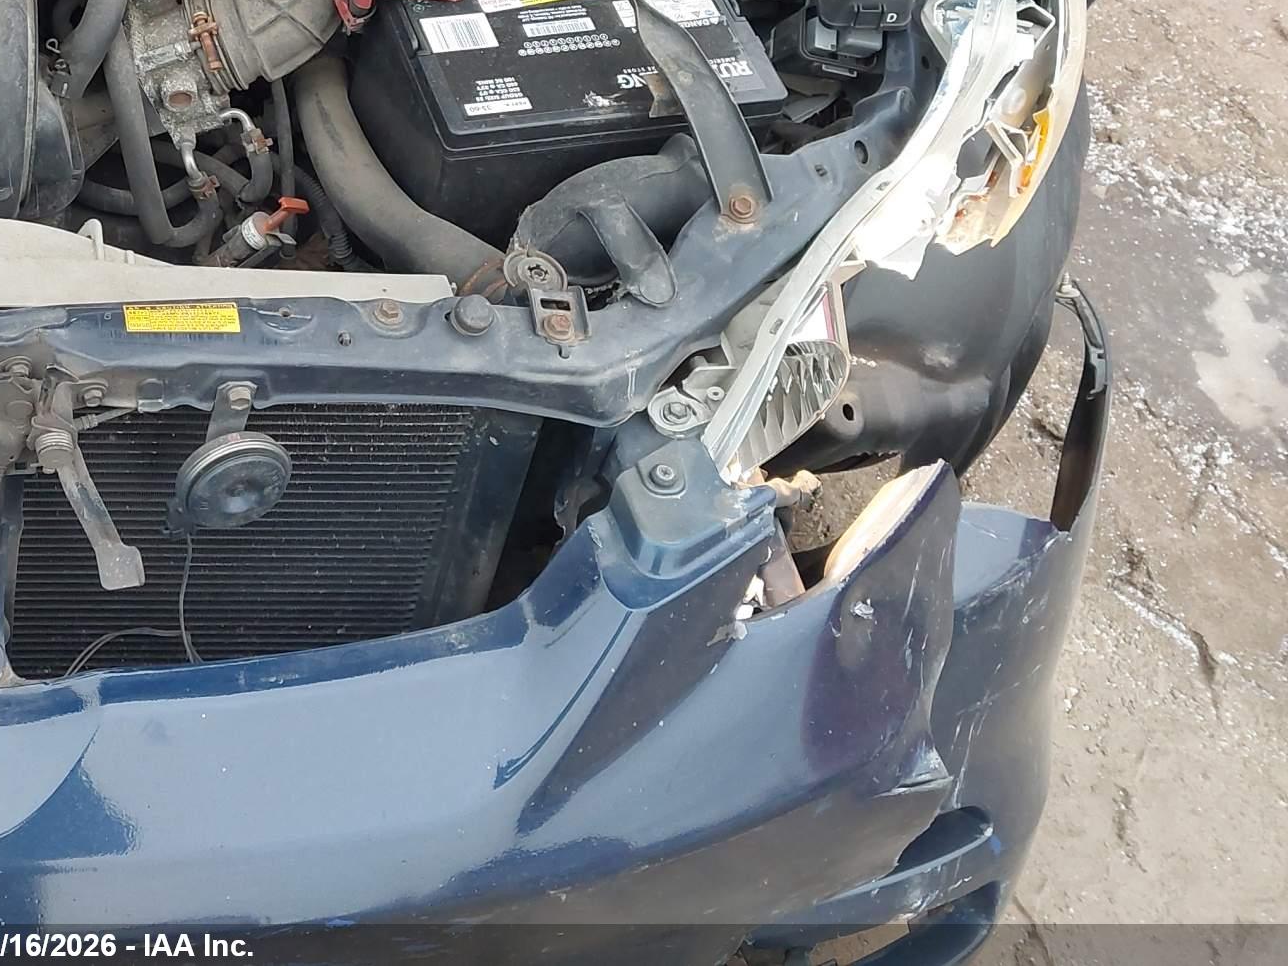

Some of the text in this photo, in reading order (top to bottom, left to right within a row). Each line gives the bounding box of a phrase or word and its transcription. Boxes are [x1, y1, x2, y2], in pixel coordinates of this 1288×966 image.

[886, 12, 898, 23] D
[709, 56, 736, 65] AMERIC
[616, 60, 754, 89] RU NG
